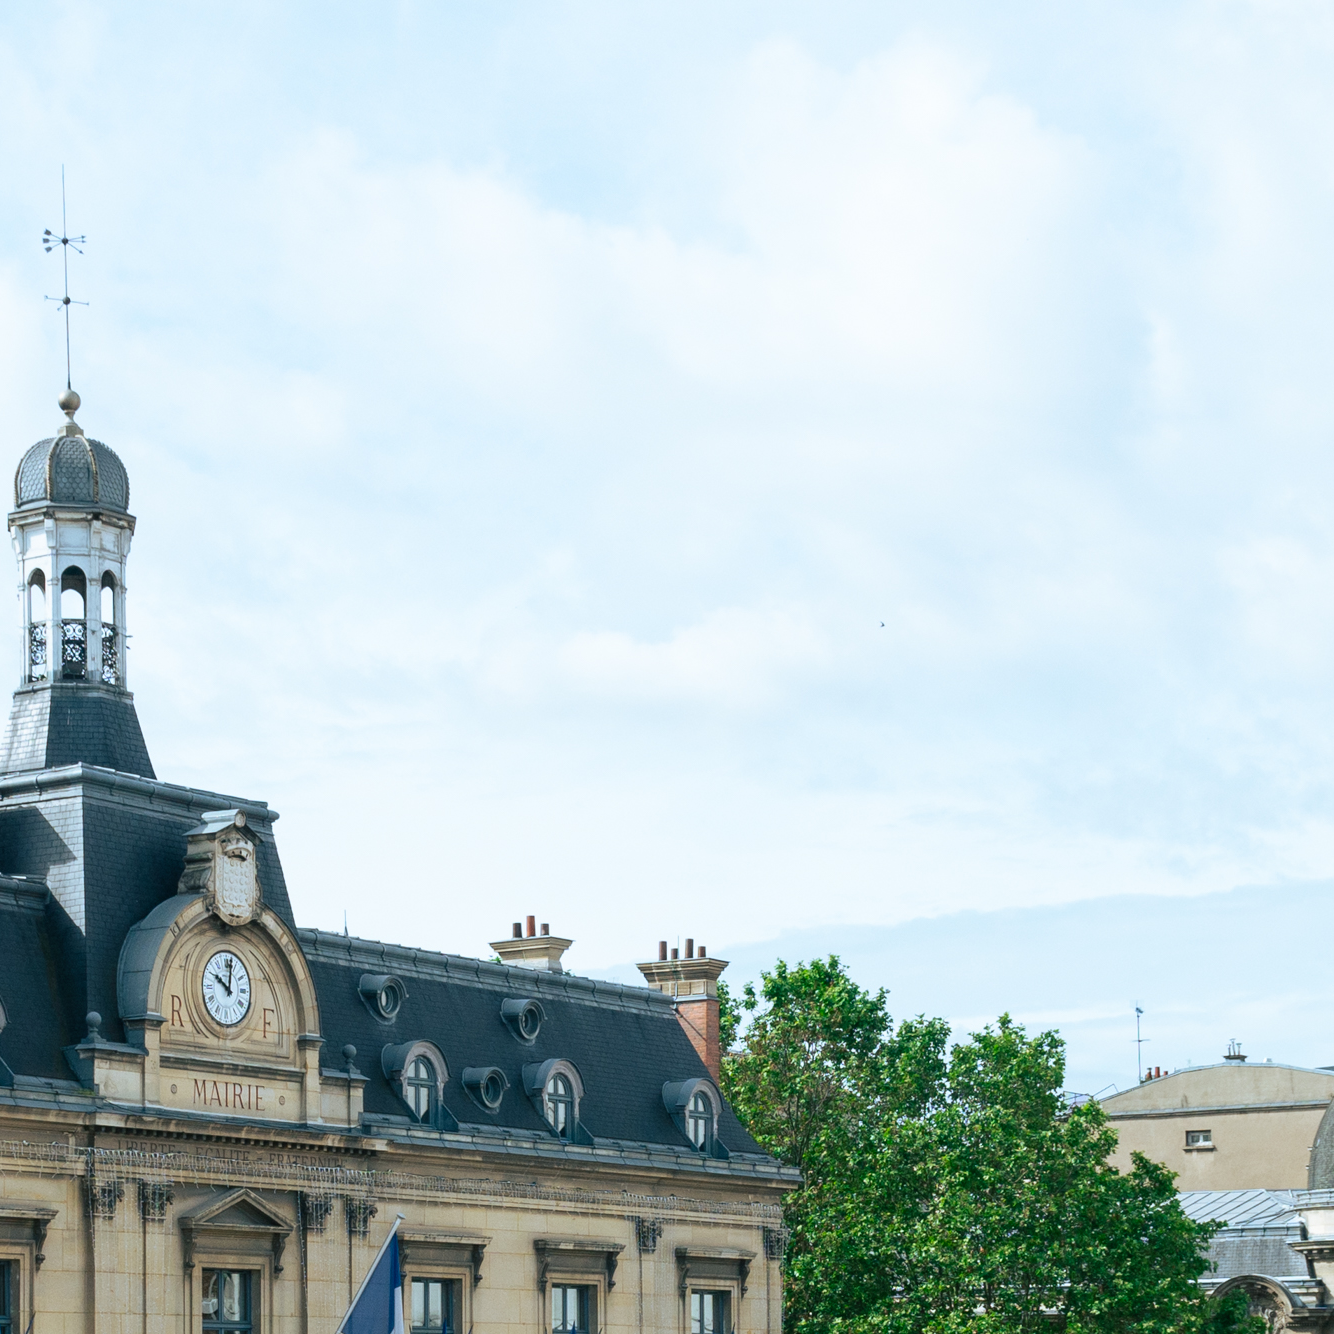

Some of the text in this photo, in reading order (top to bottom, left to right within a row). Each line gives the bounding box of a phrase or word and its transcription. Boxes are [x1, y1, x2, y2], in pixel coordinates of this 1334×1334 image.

[171, 995, 274, 1038] R F
[192, 1077, 267, 1112] MAIRIE
